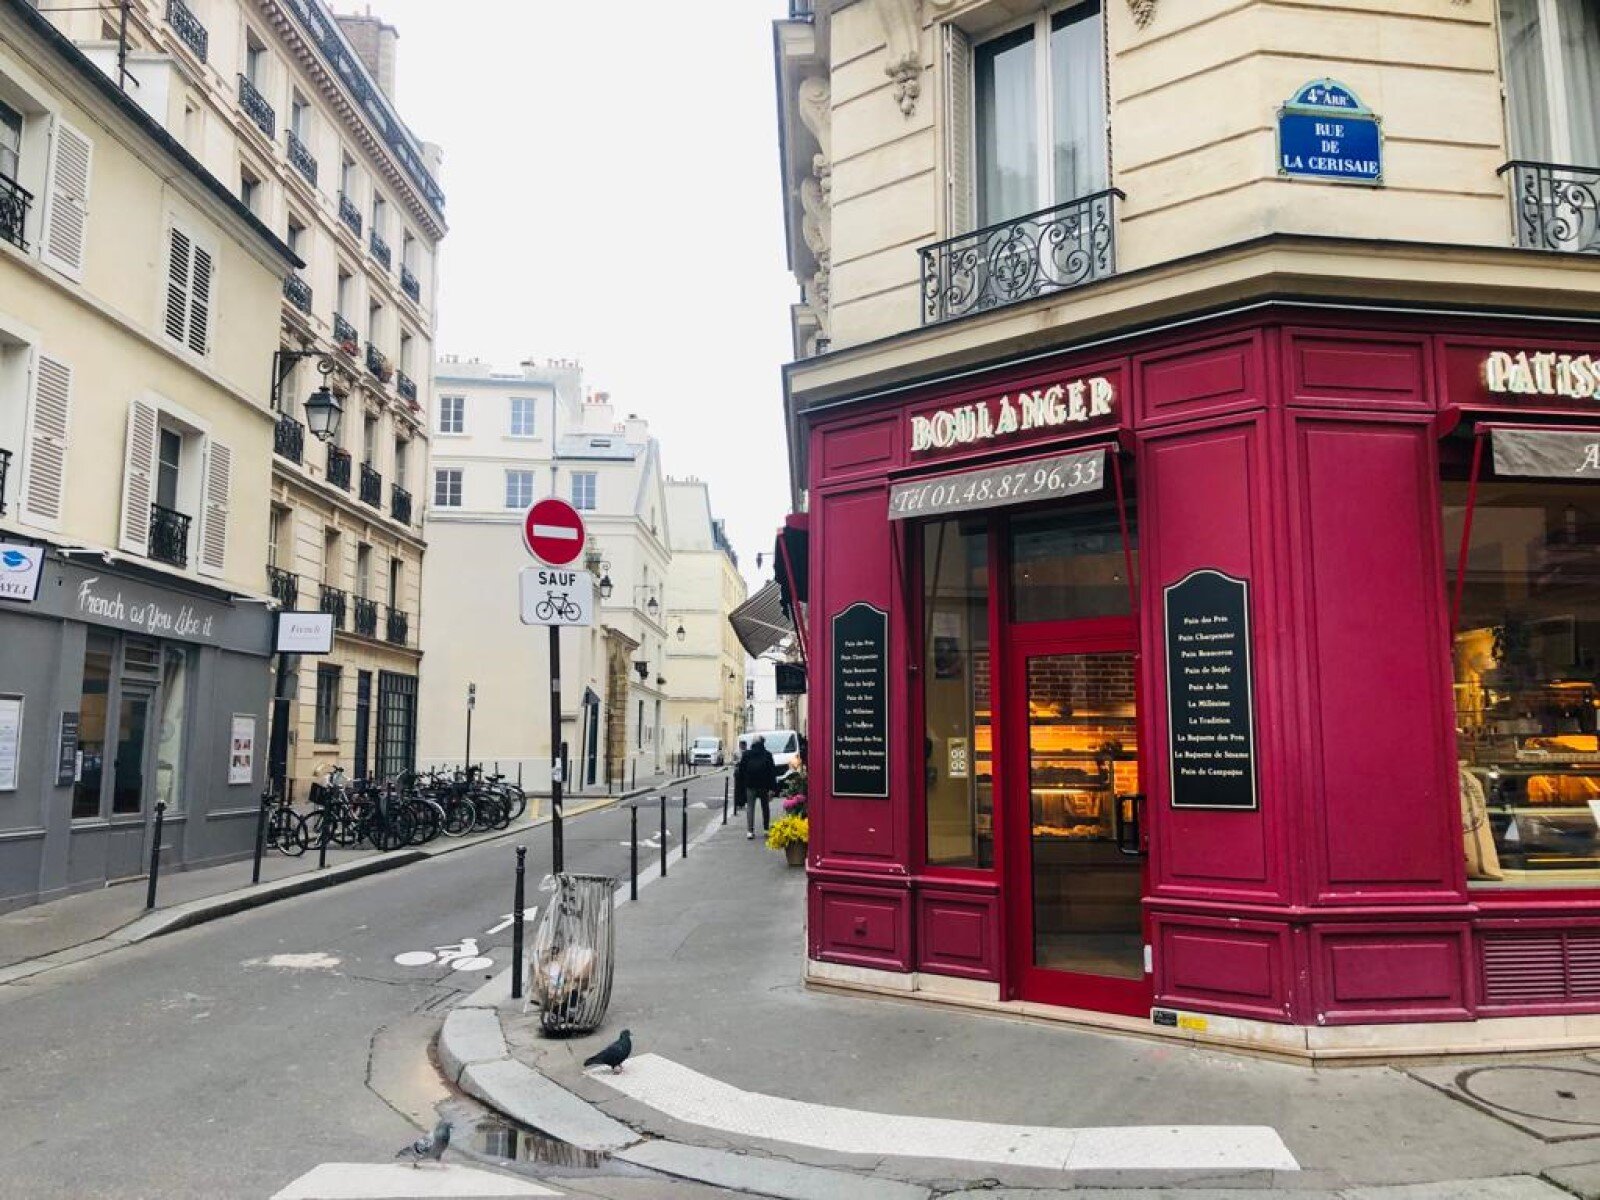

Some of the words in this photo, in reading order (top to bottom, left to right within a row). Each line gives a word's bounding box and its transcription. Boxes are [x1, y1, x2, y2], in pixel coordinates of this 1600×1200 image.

[1314, 122, 1345, 138] RUE
[1321, 140, 1340, 154] DE
[1283, 154, 1303, 169] LA
[1308, 156, 1379, 174] CERISAIE
[911, 377, 1113, 451] BOULANGER
[930, 460, 1097, 508] 01.48.87.96.33
[538, 571, 576, 587] SAUF
[78, 576, 125, 620] French
[130, 605, 145, 624] as
[147, 602, 171, 634] You
[174, 605, 200, 636] Like
[202, 616, 213, 637] it
